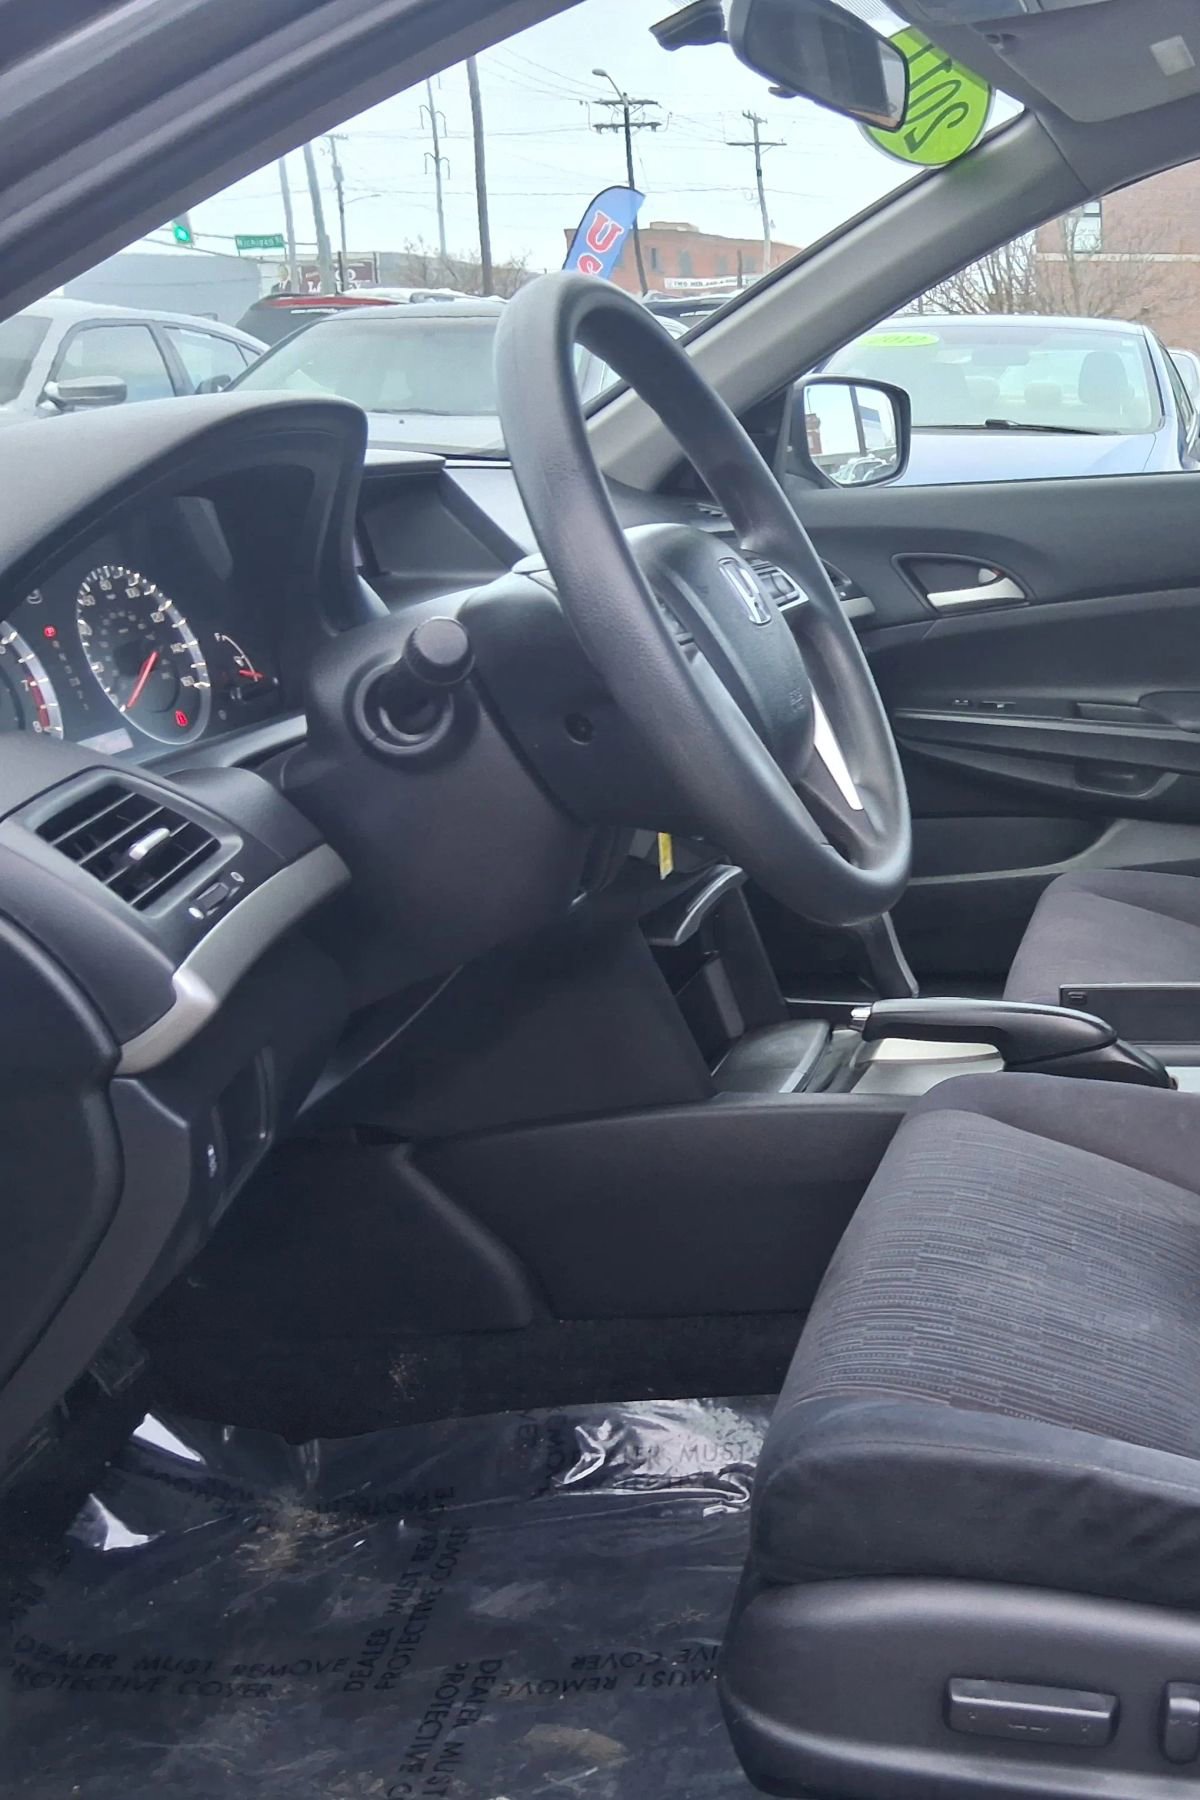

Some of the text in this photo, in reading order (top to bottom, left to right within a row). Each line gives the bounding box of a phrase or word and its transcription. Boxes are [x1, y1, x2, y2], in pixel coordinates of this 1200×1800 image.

[678, 1440, 749, 1463] MUST
[344, 1626, 394, 1693] DEALER
[384, 1570, 423, 1616] MUST
[373, 1586, 443, 1692] PROTECTIVE
[13, 1633, 350, 1680] DEALER MUST REMOVE
[570, 1650, 664, 1671] COVER
[177, 1678, 274, 1699] COVER
[500, 1667, 717, 1698] MUST REMOVE
[421, 1657, 503, 1798] DEALER MUST
